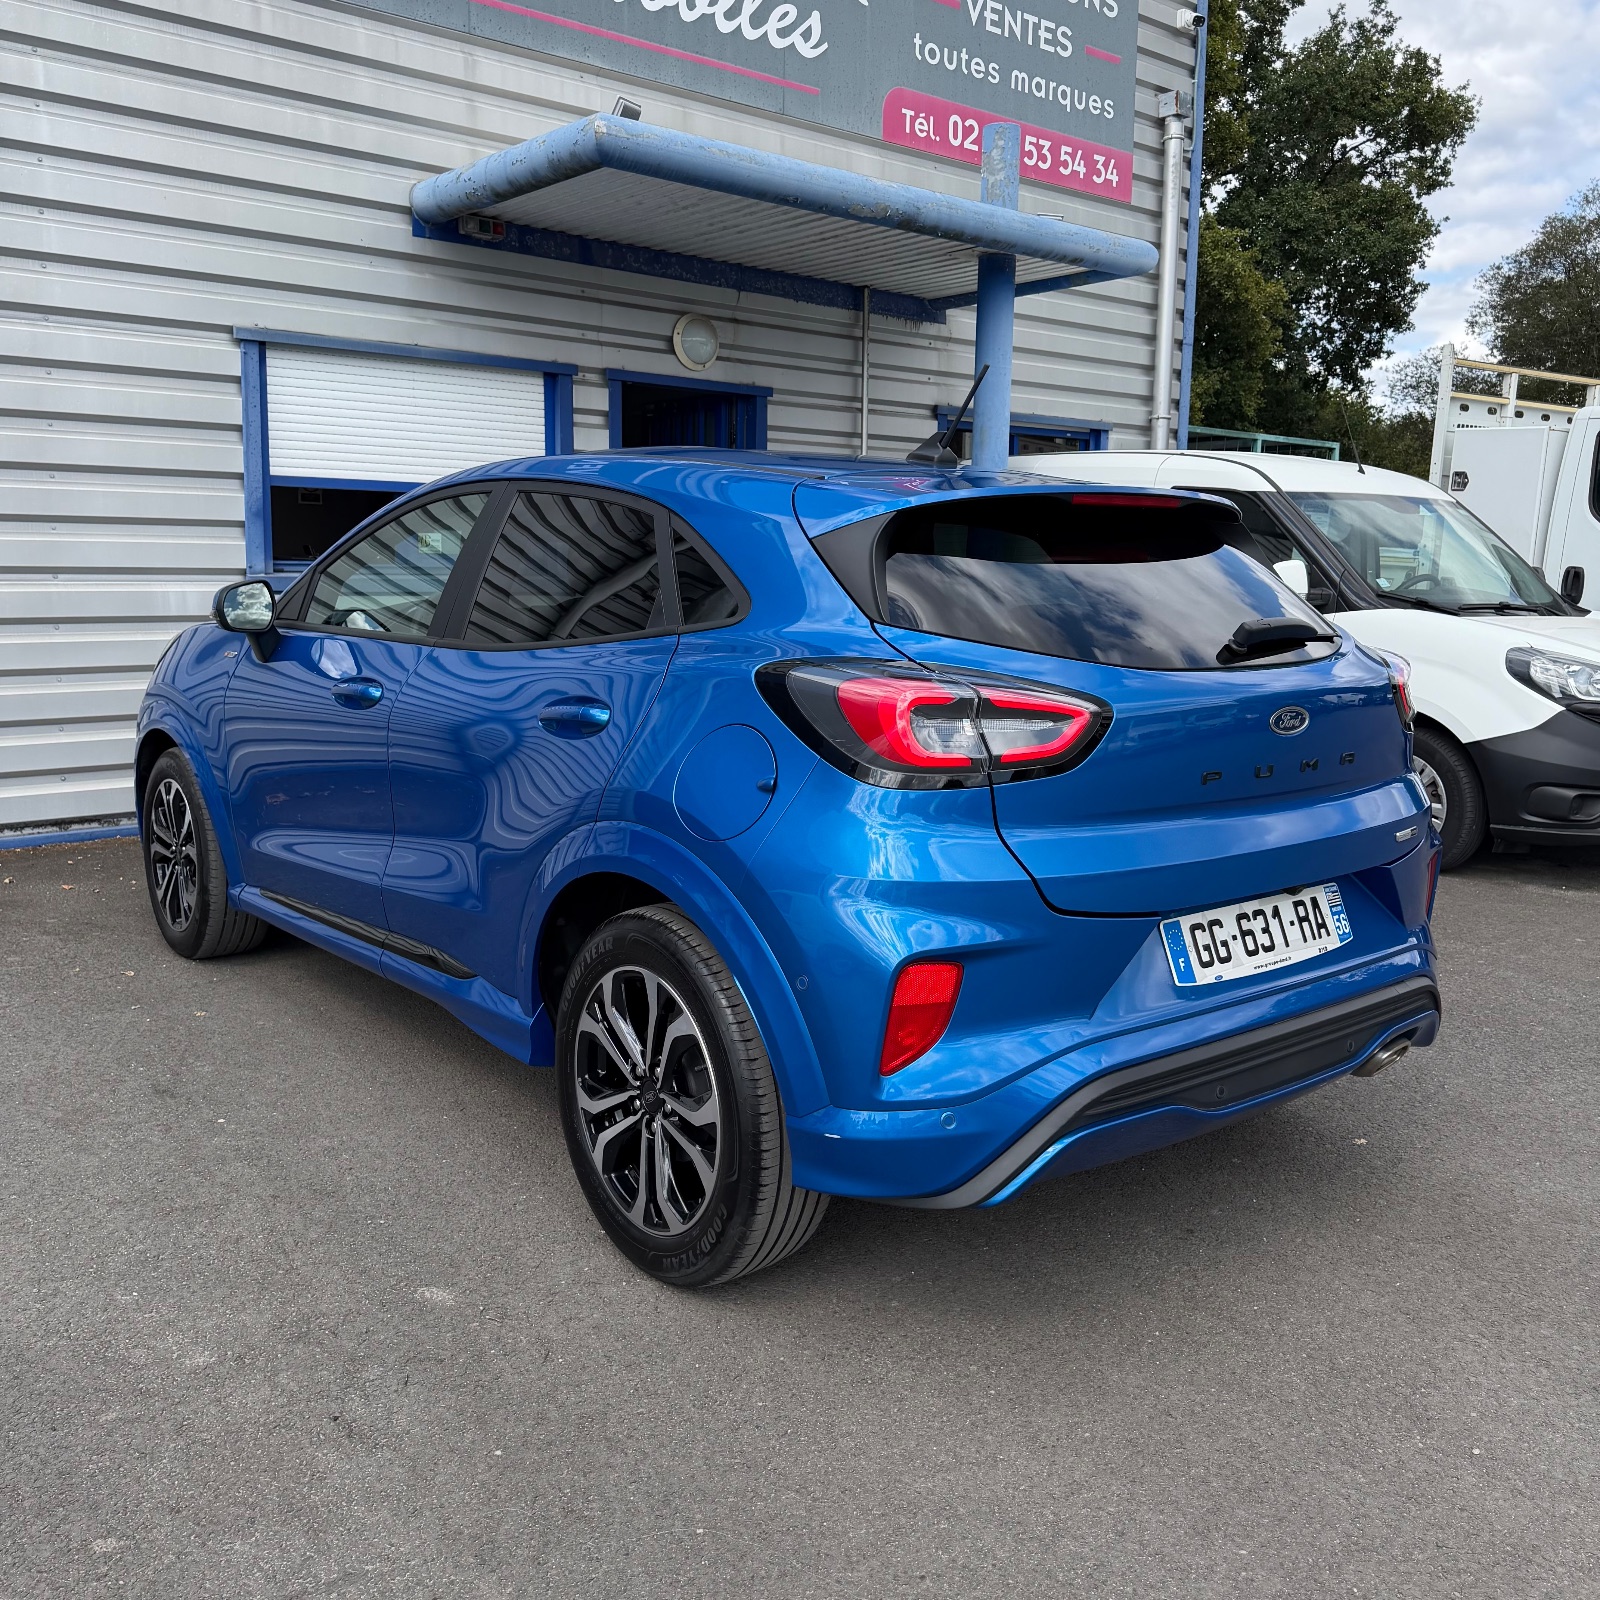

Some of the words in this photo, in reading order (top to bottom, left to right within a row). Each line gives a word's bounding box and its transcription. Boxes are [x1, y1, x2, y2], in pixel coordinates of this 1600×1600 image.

[966, 0, 1073, 58] VENTES
[913, 32, 1000, 85] toutes
[1010, 69, 1115, 120] marques
[901, 107, 941, 142] Tél.
[948, 114, 980, 152] 02
[1023, 135, 1052, 170] 53
[1058, 145, 1087, 179] 54
[1092, 152, 1119, 188] 34
[1279, 712, 1301, 729] Ford
[1201, 751, 1356, 786] PUMA
[1189, 896, 1331, 969] GG-631-RA
[1333, 912, 1350, 936] 56
[1177, 957, 1186, 972] F
